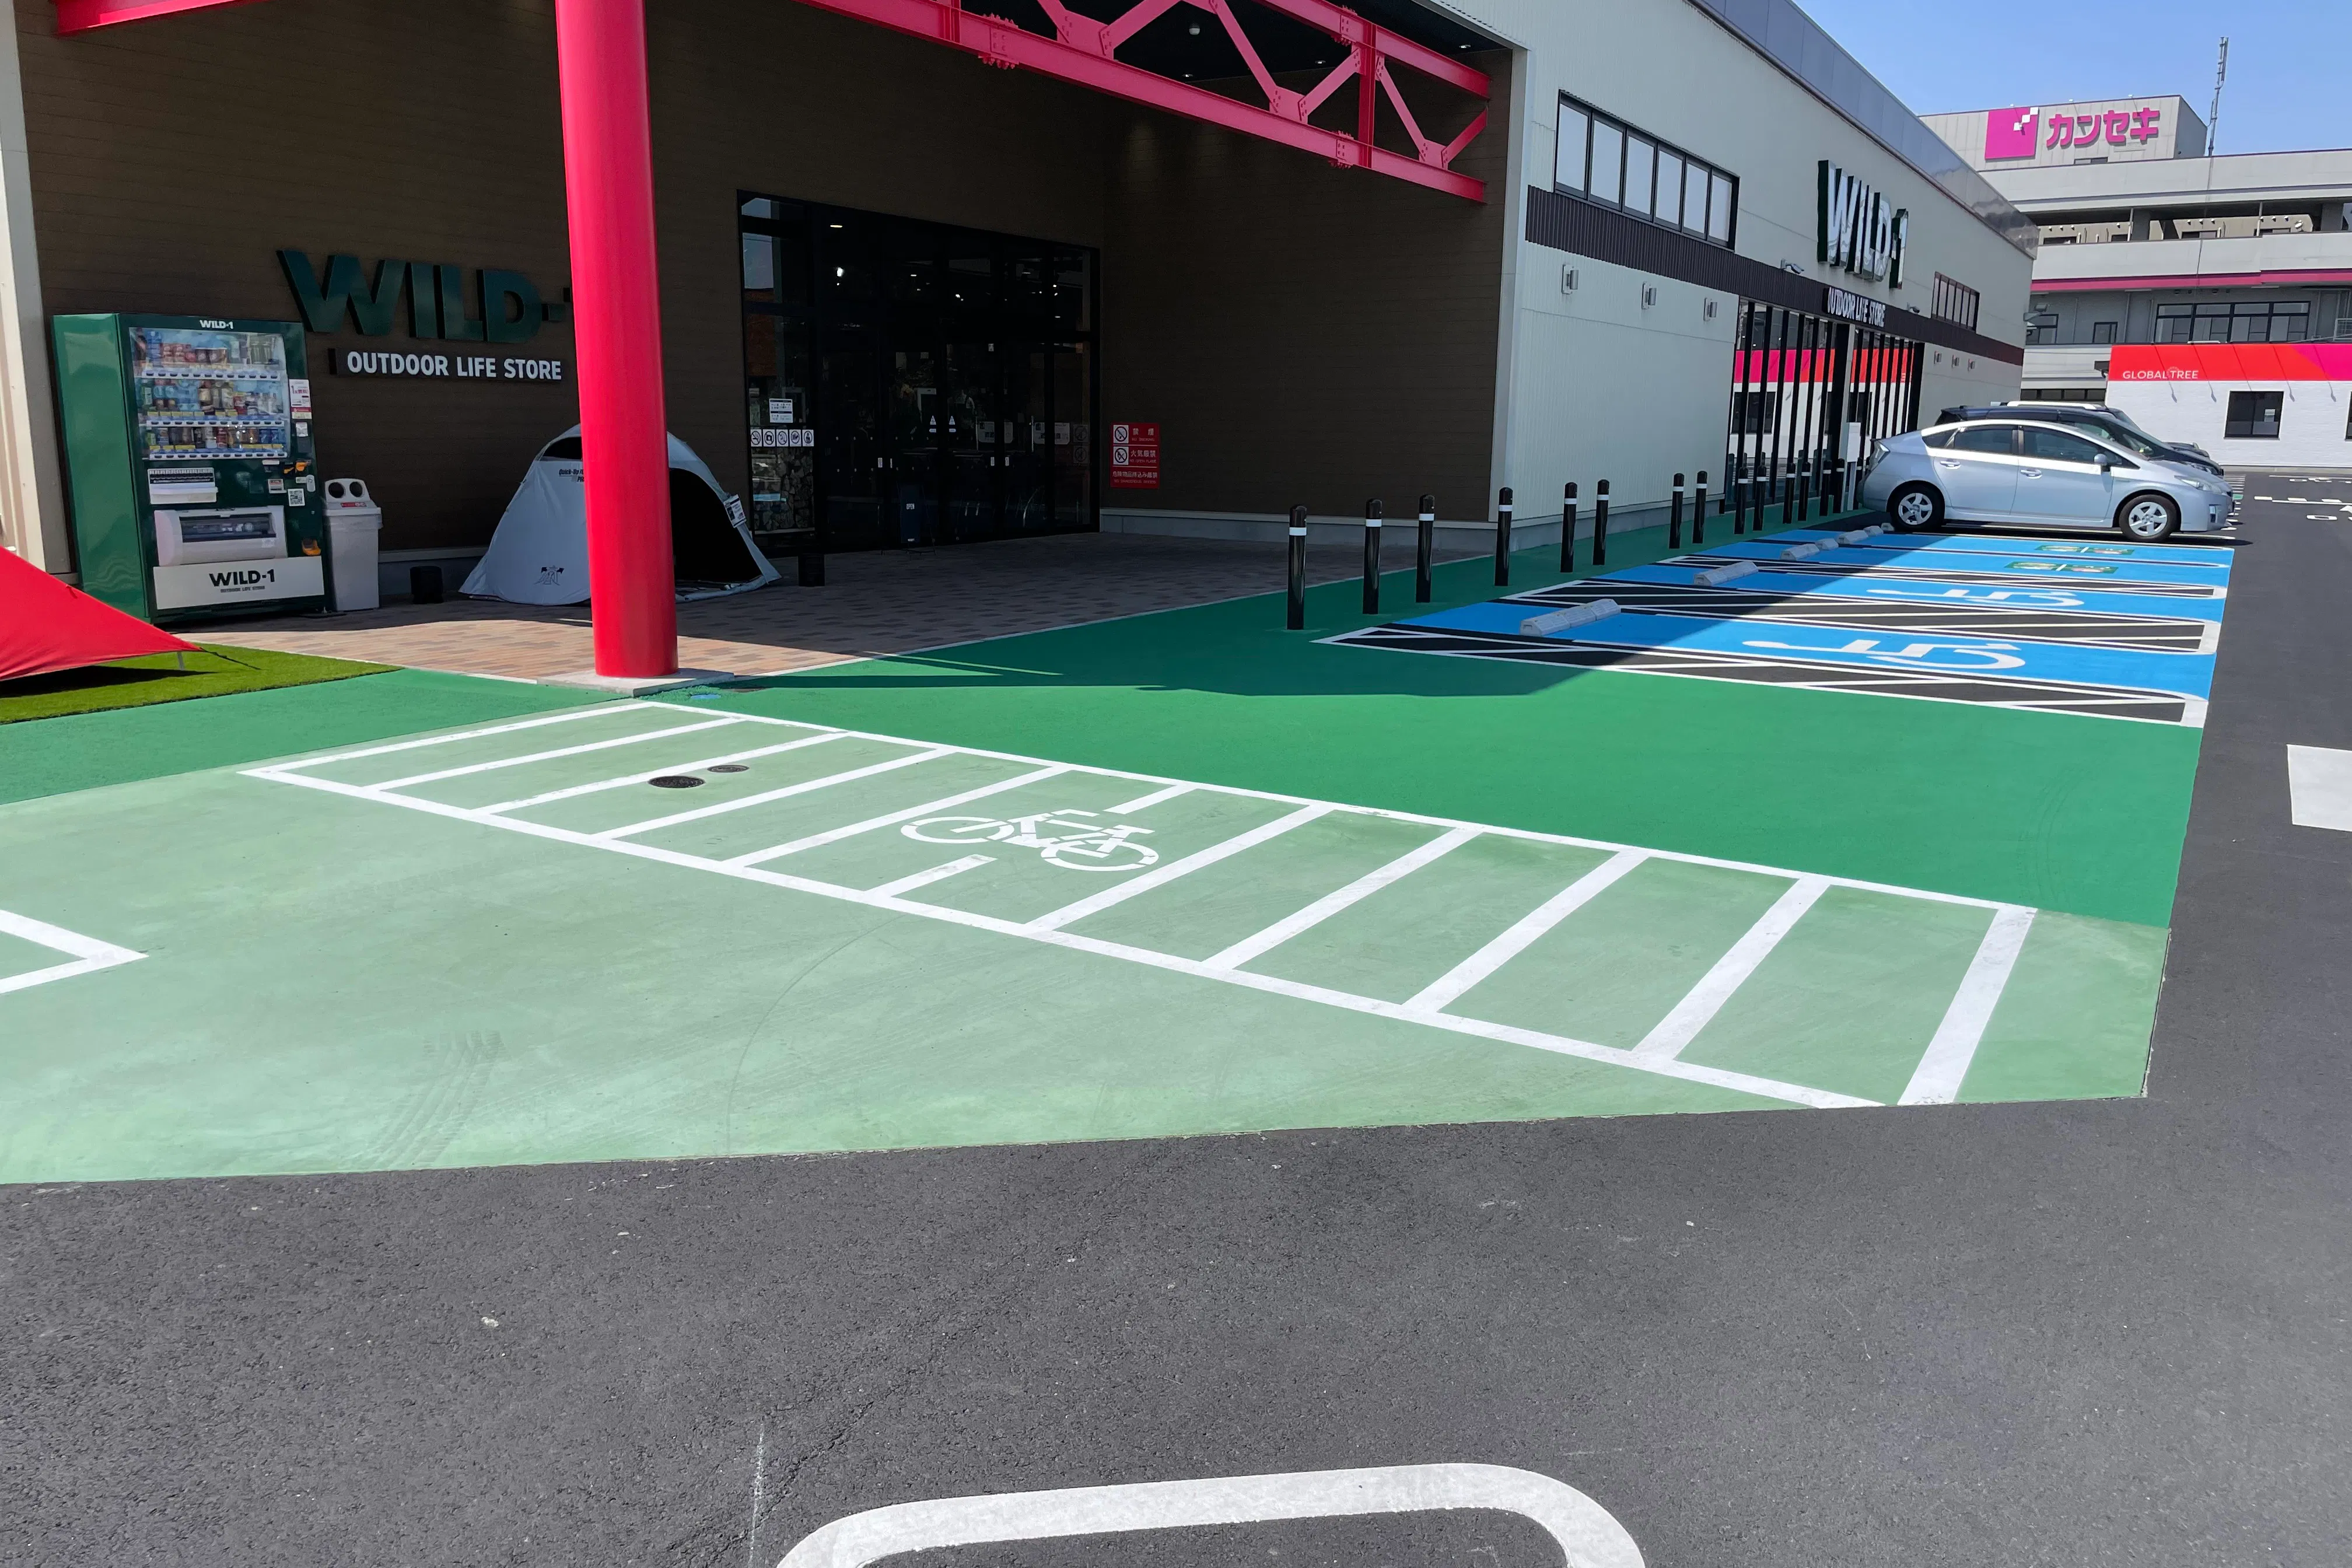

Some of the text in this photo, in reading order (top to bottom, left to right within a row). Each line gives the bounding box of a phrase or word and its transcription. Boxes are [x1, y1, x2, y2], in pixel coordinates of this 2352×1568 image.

[2046, 107, 2160, 148] カンセキ
[1818, 160, 1909, 290] WILD-1
[276, 249, 573, 343] WILD-
[1828, 286, 1886, 327] OUTDOOR LIFE STORE
[200, 320, 233, 329] WILD-1
[347, 351, 562, 380] OUTDOOR LIFE STORE
[2122, 370, 2199, 379] GLOBAL TREE
[209, 569, 275, 587] WILD-1
